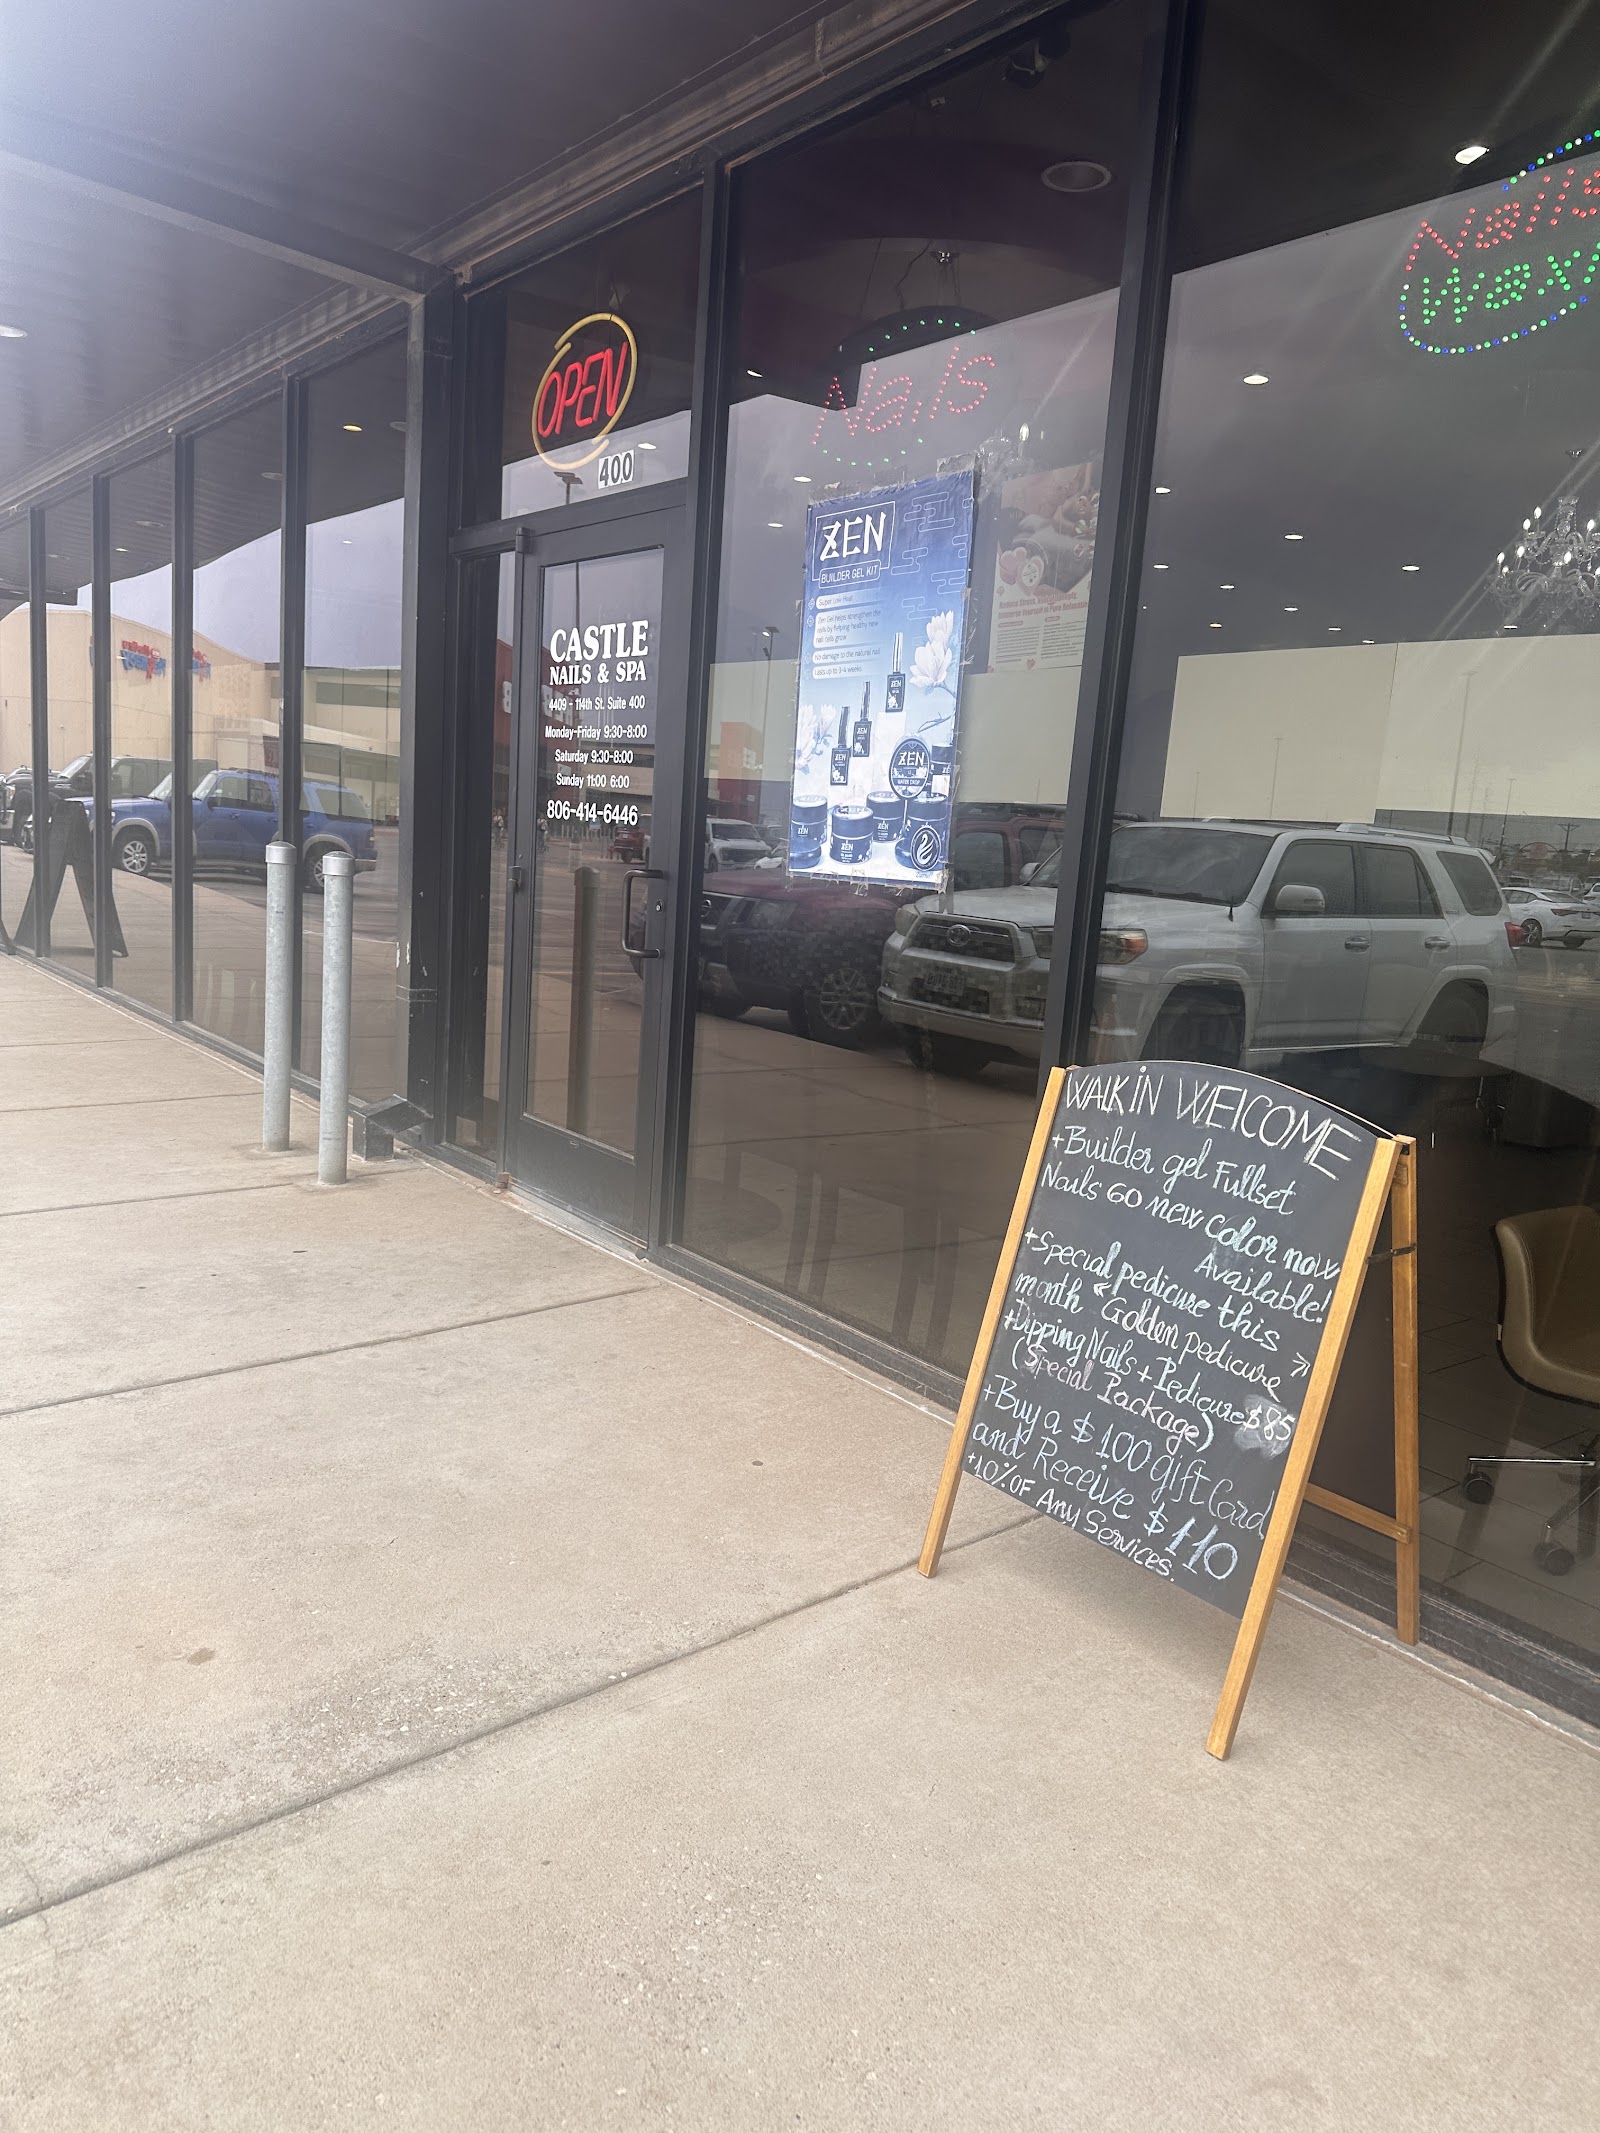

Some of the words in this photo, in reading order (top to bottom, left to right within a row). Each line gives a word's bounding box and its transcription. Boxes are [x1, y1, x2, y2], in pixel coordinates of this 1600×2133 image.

[537, 341, 629, 438] OPEN
[812, 345, 996, 445] Nails
[599, 452, 633, 487] 400
[820, 511, 887, 561] ZEN
[821, 570, 851, 584] BUILDER
[851, 568, 864, 579] GEL
[866, 565, 879, 576] KIT
[550, 620, 649, 663] CASTLE
[550, 664, 592, 685] NAILS
[597, 662, 609, 683] &
[616, 660, 647, 682] SPA
[549, 698, 567, 711] 4409
[575, 697, 592, 711] 114th
[594, 697, 605, 710] St.
[607, 696, 626, 710] Suite
[629, 695, 645, 709] 400
[545, 725, 601, 740] Monday-Friday
[604, 724, 648, 739] 9:30-8:00
[555, 749, 589, 765] Saturday
[591, 750, 634, 764] 9:30-8:00
[898, 751, 925, 766] ZEN
[556, 773, 584, 788] Sunday
[586, 774, 607, 788] 11:00
[610, 775, 630, 788] 6:00
[547, 800, 639, 825] 806-414-6446
[840, 843, 854, 851] ZEN
[1176, 1077, 1363, 1181] WELCOME
[1161, 1138, 1213, 1194] gel
[1212, 1160, 1297, 1216] Fullset
[1041, 1160, 1102, 1201] Nails
[1145, 1195, 1205, 1230] new
[1282, 1247, 1342, 1281] now
[1193, 1251, 1333, 1324] Available!
[1014, 1271, 1085, 1315] month
[1100, 1296, 1181, 1351] Golden
[1217, 1294, 1282, 1352] this
[1084, 1326, 1138, 1377] Nails
[971, 1420, 1027, 1461] and
[1033, 1435, 1136, 1521] Receive
[1042, 1409, 1064, 1437] a
[1208, 1478, 1276, 1541] Card
[1036, 1487, 1081, 1530] Any
